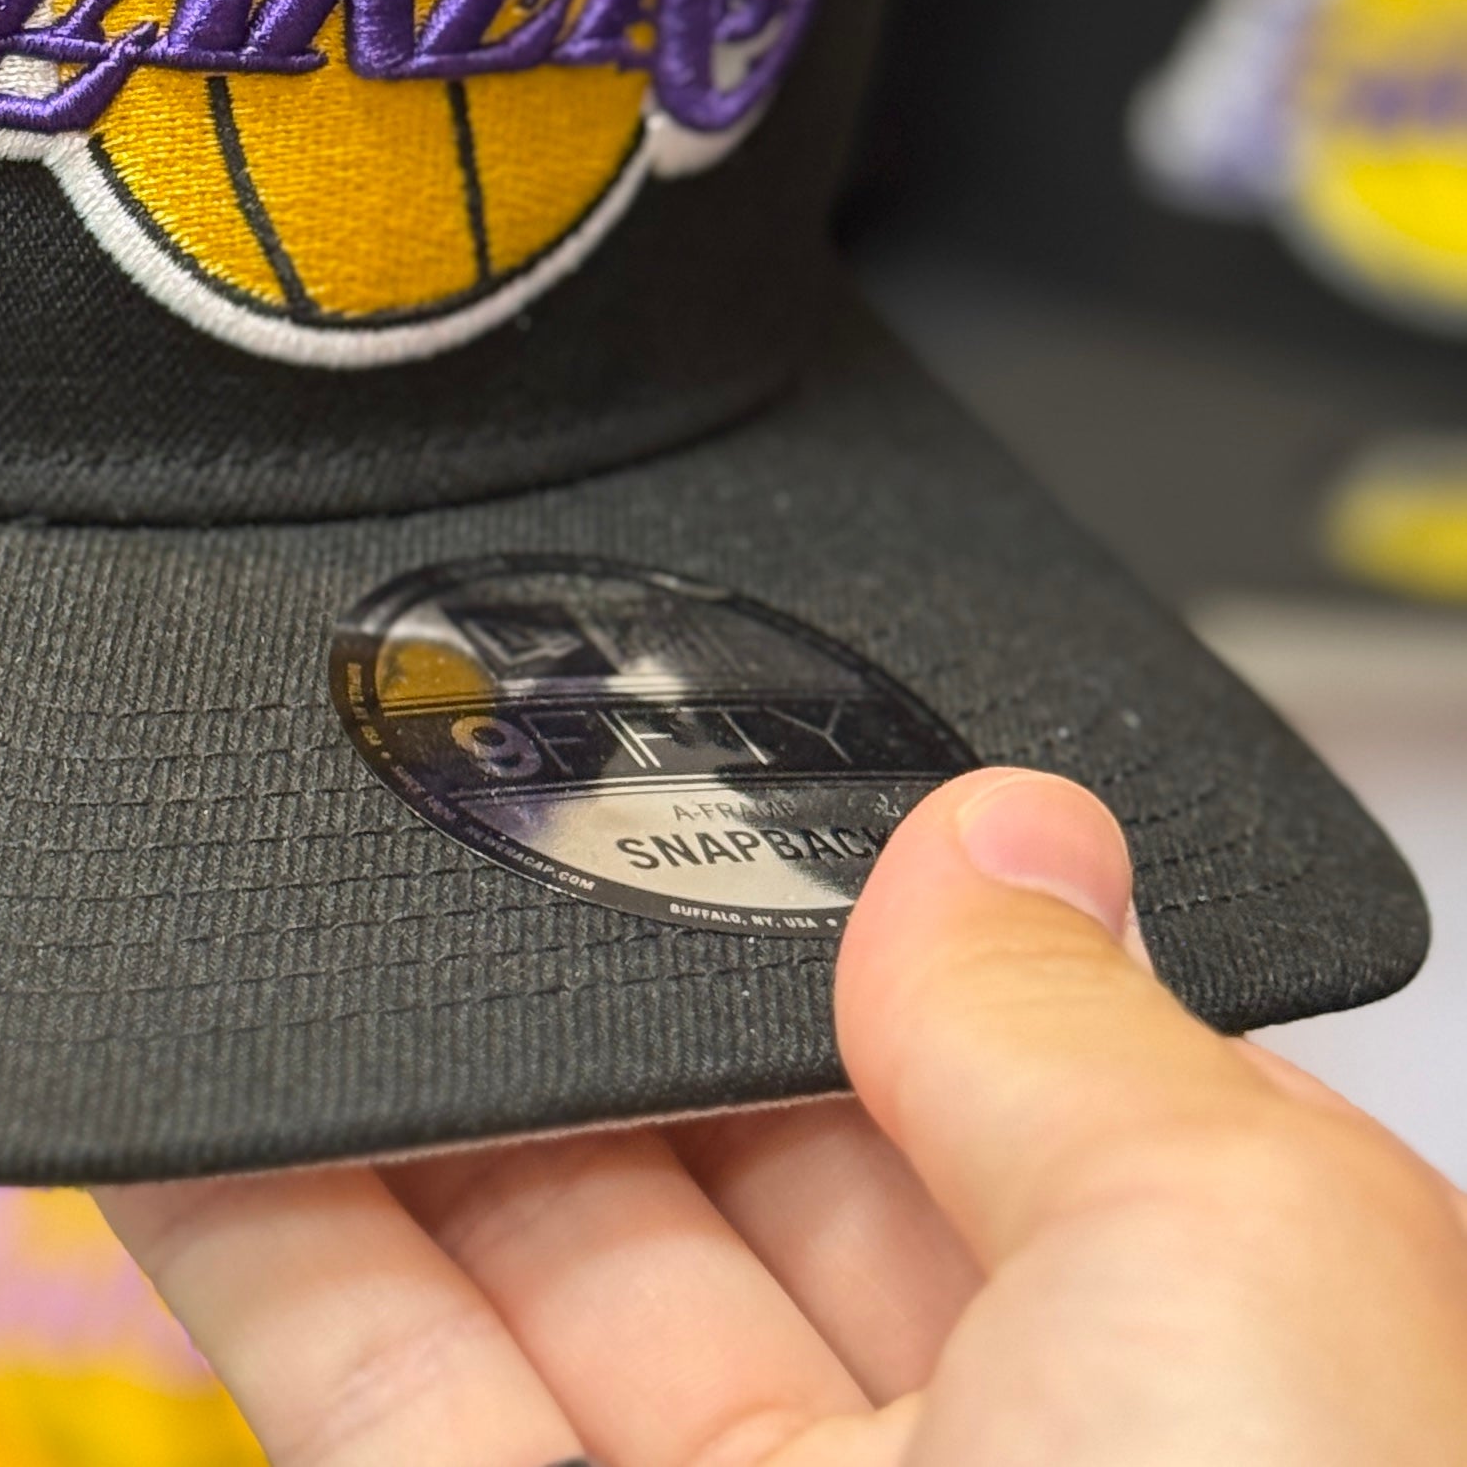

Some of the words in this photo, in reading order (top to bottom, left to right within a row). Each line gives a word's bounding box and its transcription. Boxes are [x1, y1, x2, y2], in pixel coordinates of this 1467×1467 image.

[449, 695, 847, 779] 9FIFTY
[669, 902, 749, 926] BUFFALO,
[750, 914, 782, 929] NY,
[783, 916, 819, 929] USA
